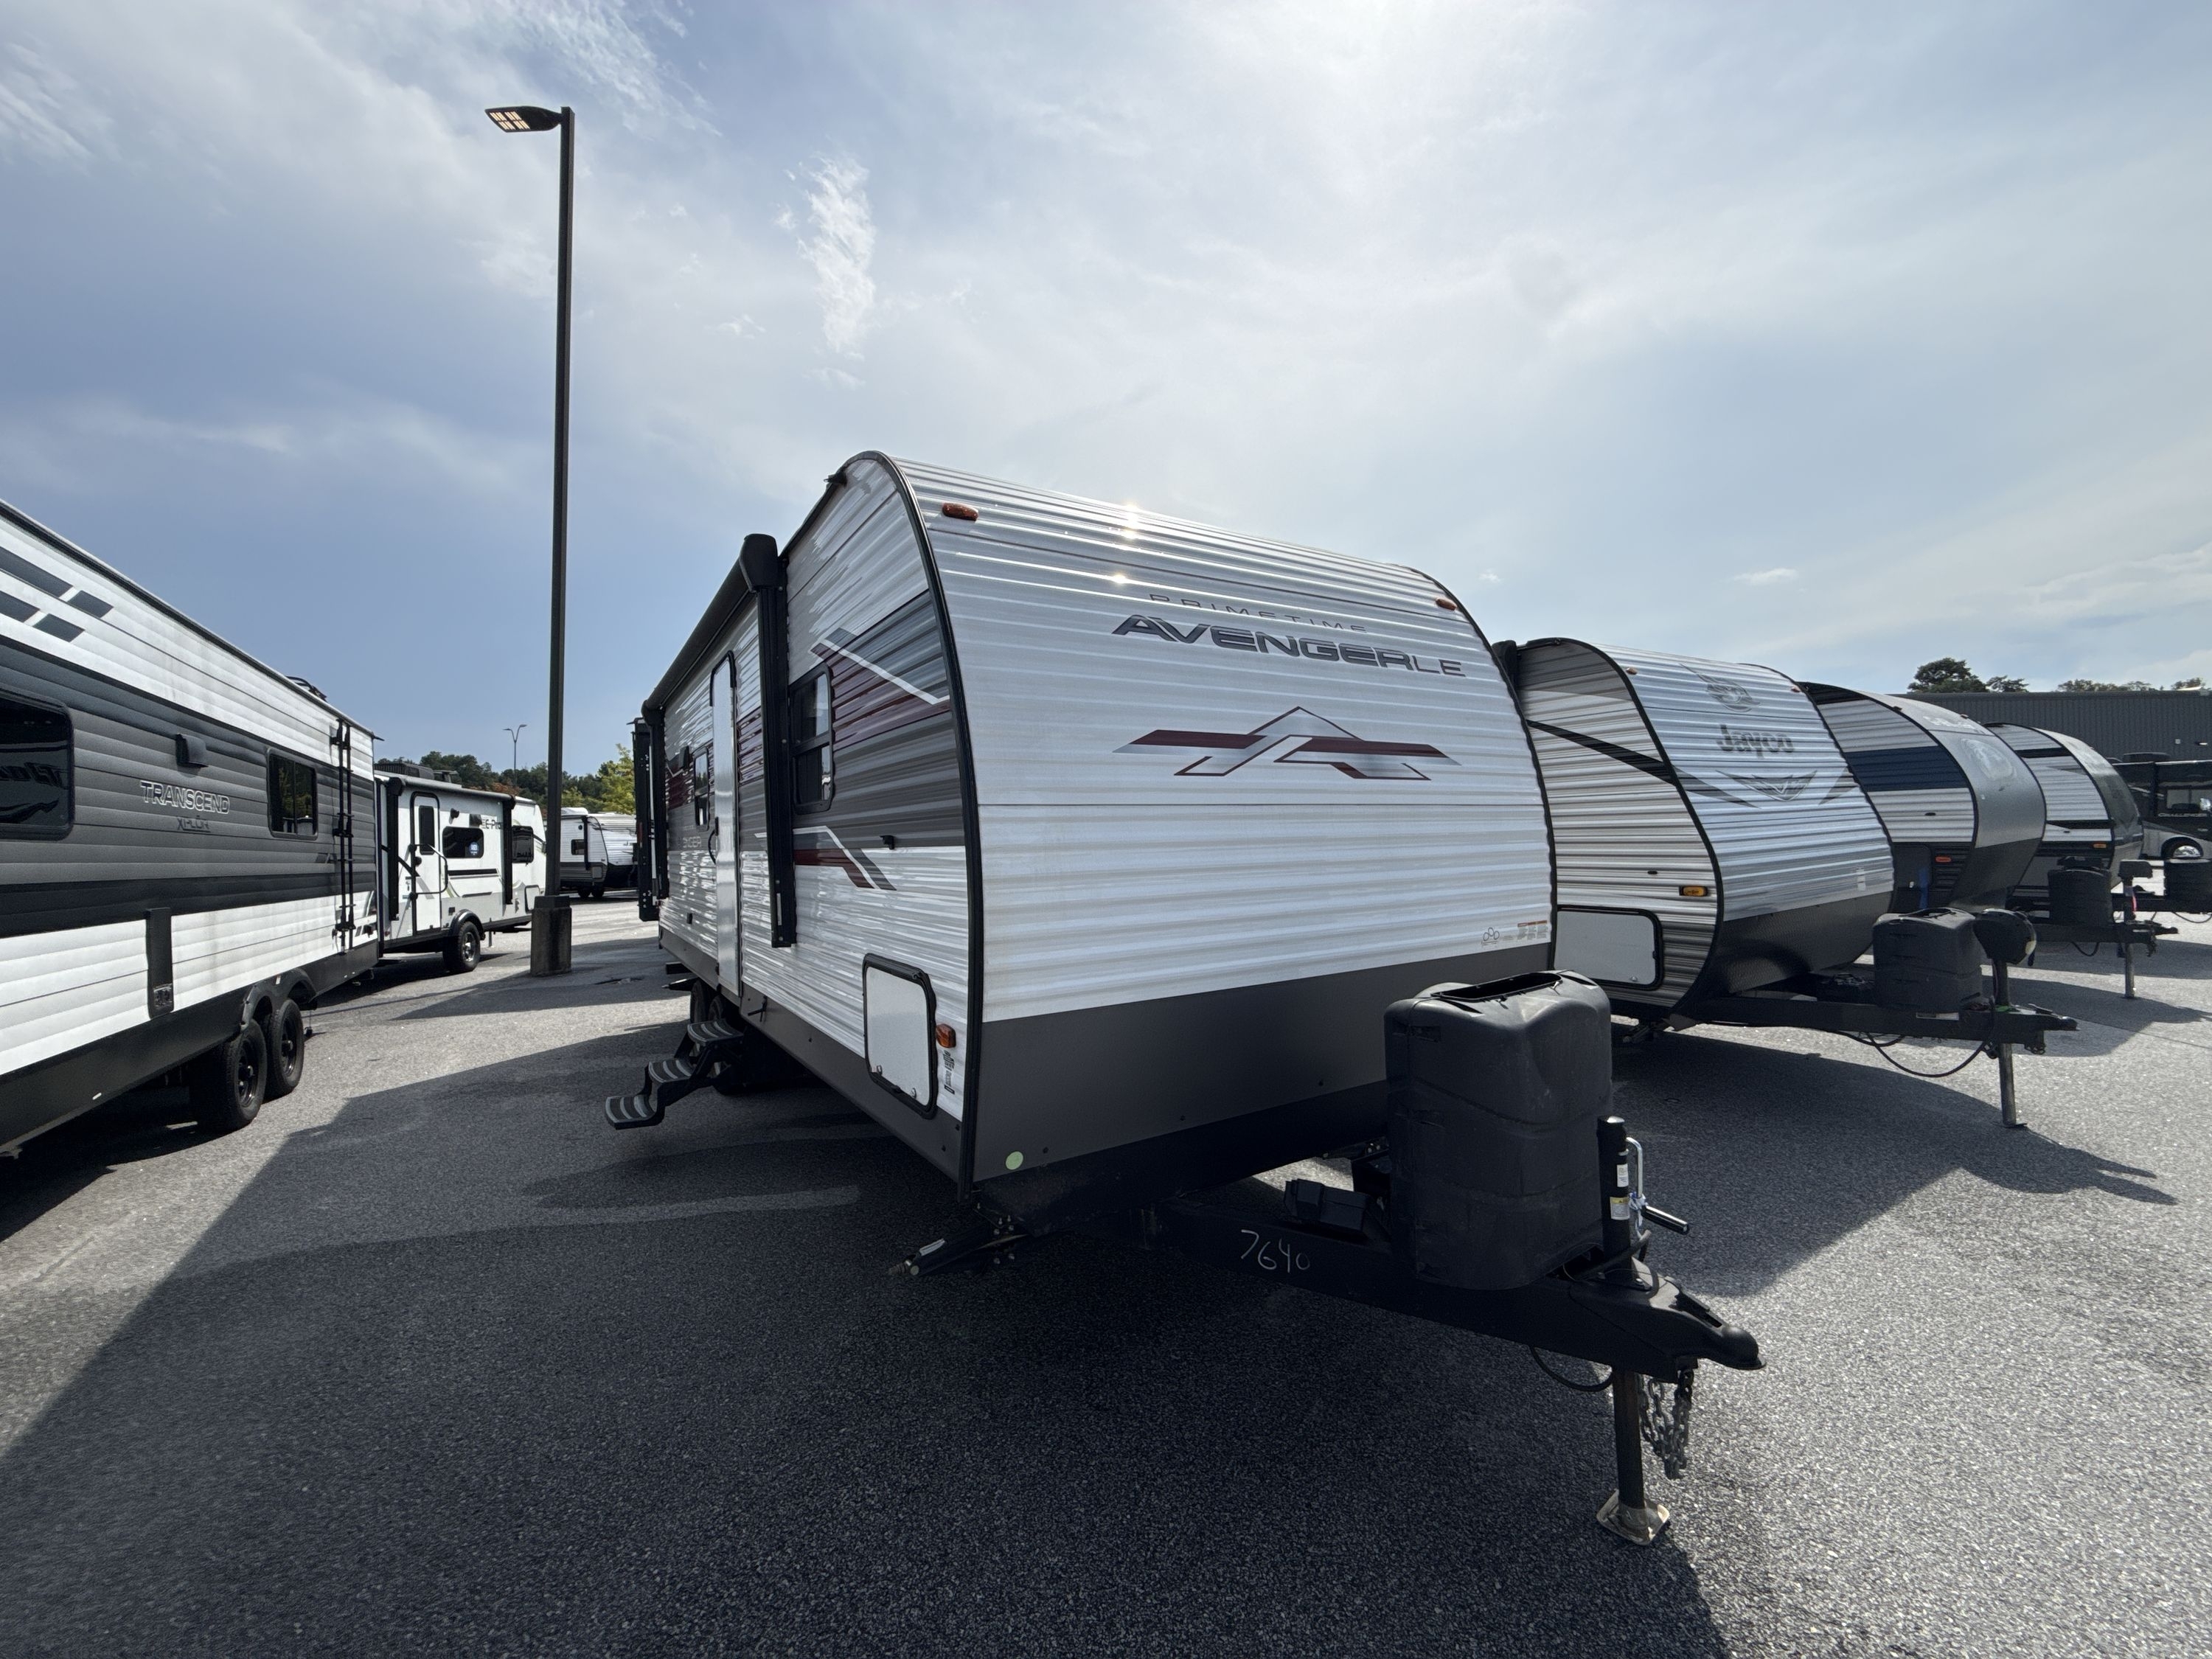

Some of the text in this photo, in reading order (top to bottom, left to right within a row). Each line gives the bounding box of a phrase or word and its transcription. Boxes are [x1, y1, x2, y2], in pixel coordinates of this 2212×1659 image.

[1150, 594, 1367, 633] PRIMETIME
[1716, 724, 1795, 759] Jayco
[139, 780, 230, 814] TRANSCEND
[1241, 1229, 1310, 1273] 7640
